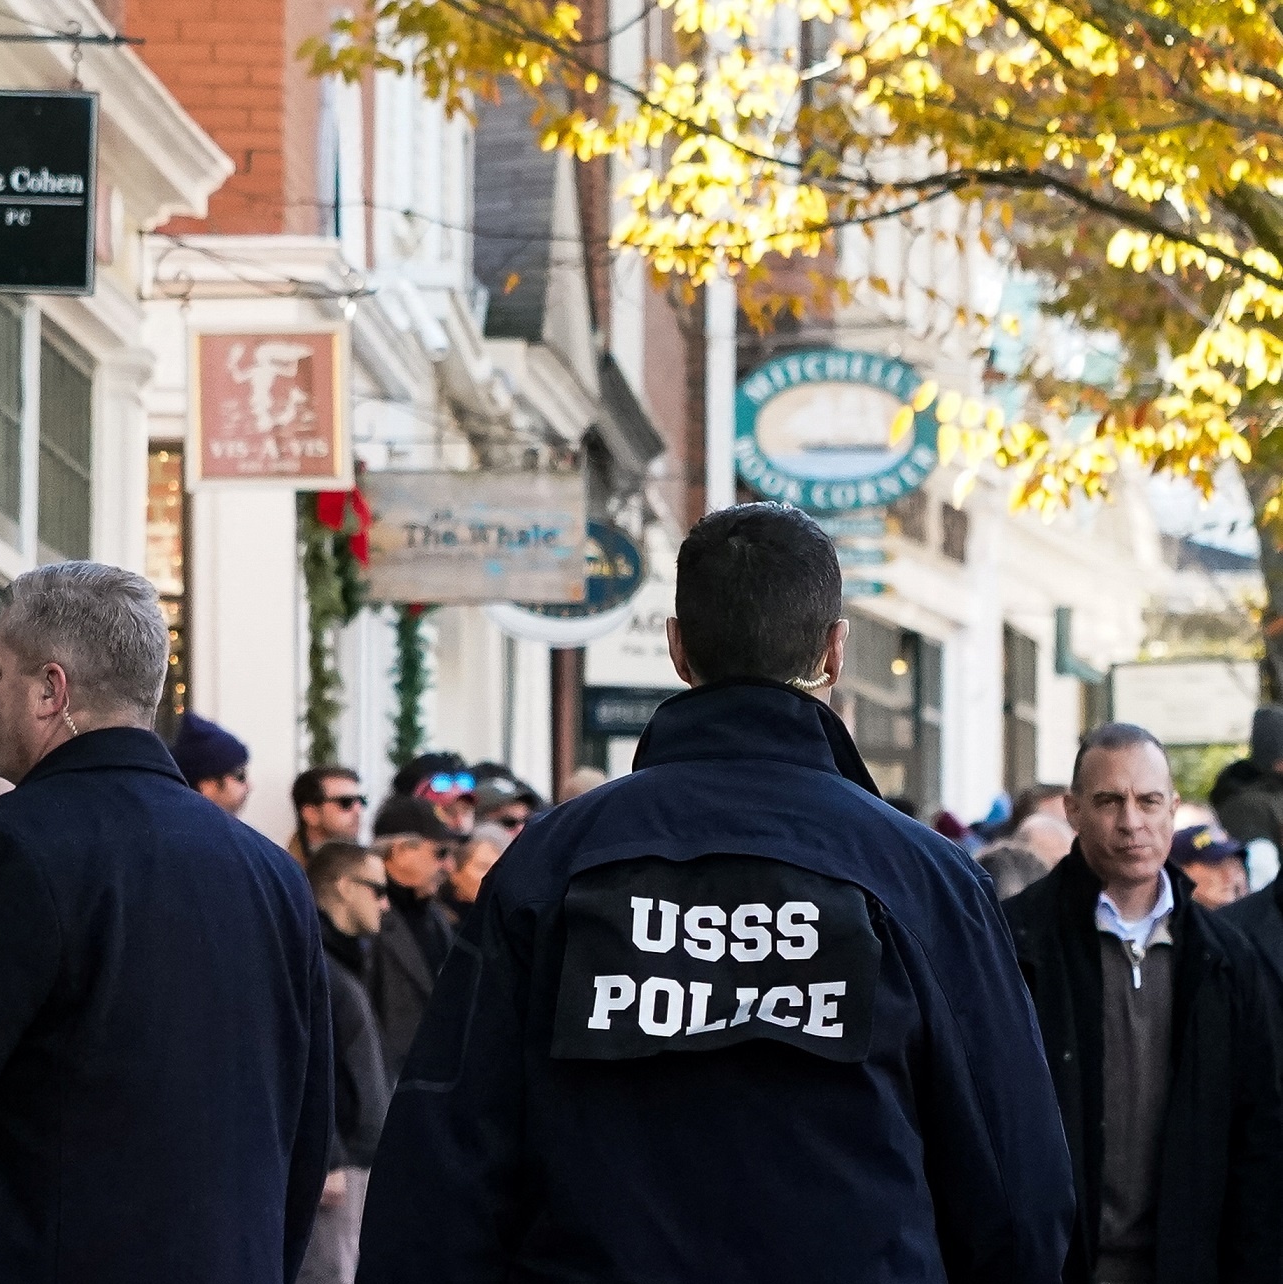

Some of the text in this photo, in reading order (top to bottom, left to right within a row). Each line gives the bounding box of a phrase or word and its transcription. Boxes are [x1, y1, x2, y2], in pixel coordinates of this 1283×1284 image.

[10, 166, 83, 194] Cohen
[5, 208, 32, 227] PC
[810, 444, 934, 509] CORNER
[630, 896, 820, 962] USSS
[587, 974, 847, 1038] POLICE
